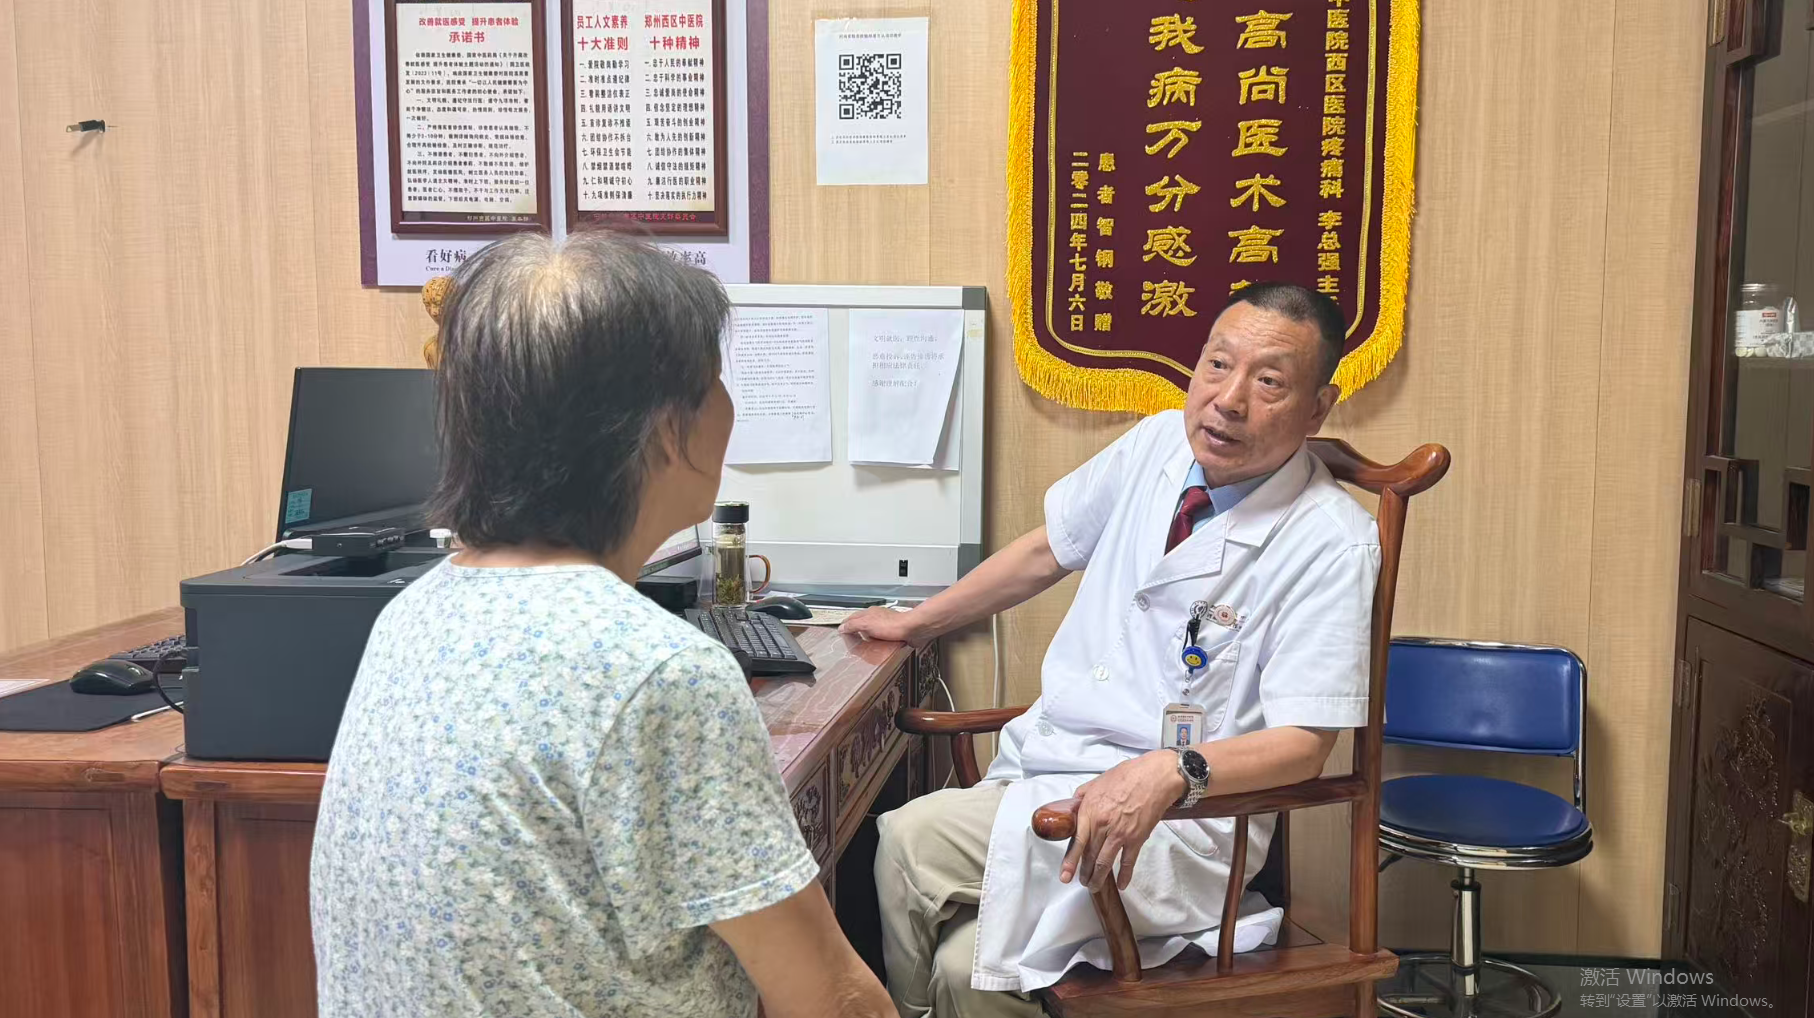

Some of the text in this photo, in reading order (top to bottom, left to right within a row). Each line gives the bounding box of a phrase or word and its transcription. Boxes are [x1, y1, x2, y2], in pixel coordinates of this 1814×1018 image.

[418, 16, 519, 27] 改善就医感受 提升患者体验
[577, 15, 628, 29] 员工人文素养
[645, 14, 703, 28] 郑州西区中医院
[448, 31, 486, 44] 承诺书
[577, 37, 628, 51] 十大准则
[650, 36, 699, 50] 十种精神
[1227, 9, 1294, 296] 高尚医术高
[1140, 13, 1206, 318] 我病万分感激
[1068, 151, 1090, 332] 二零二四年七月六日
[1093, 152, 1117, 333] 患者智钢敬赠
[425, 248, 467, 263] 看好病
[1317, 210, 1343, 301] 李总强主
